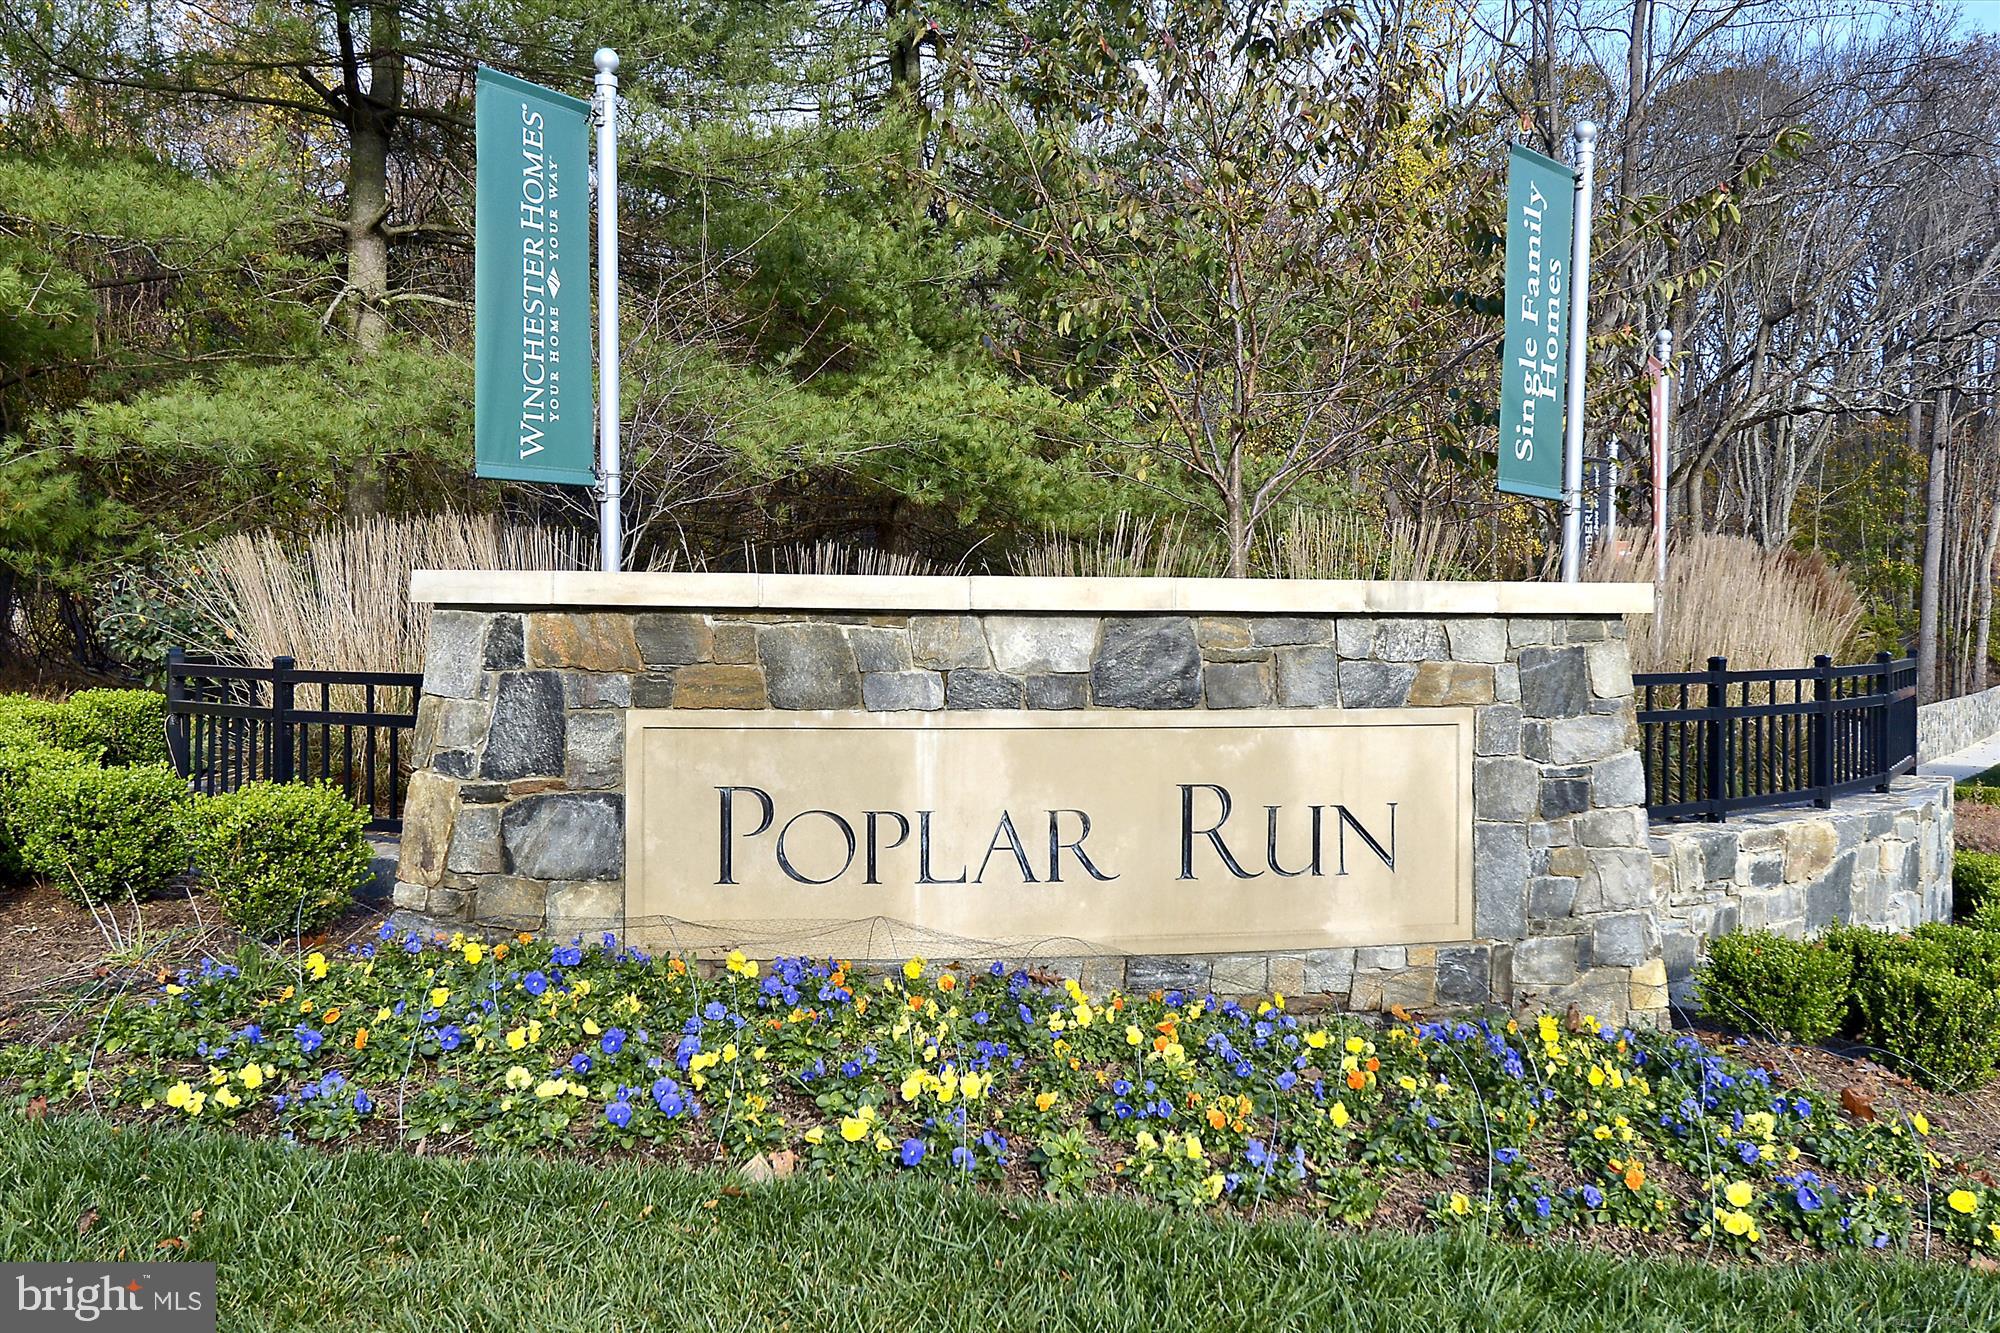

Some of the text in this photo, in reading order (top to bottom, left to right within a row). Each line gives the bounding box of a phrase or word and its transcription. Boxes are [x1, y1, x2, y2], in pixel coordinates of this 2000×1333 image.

[520, 238, 545, 460] WINCHESTER
[548, 158, 560, 423] YOUR HOME YOUR WAY
[1514, 180, 1548, 462] Single Family
[1540, 258, 1562, 402] Homes
[713, 783, 1399, 885] POPLAR RUN
